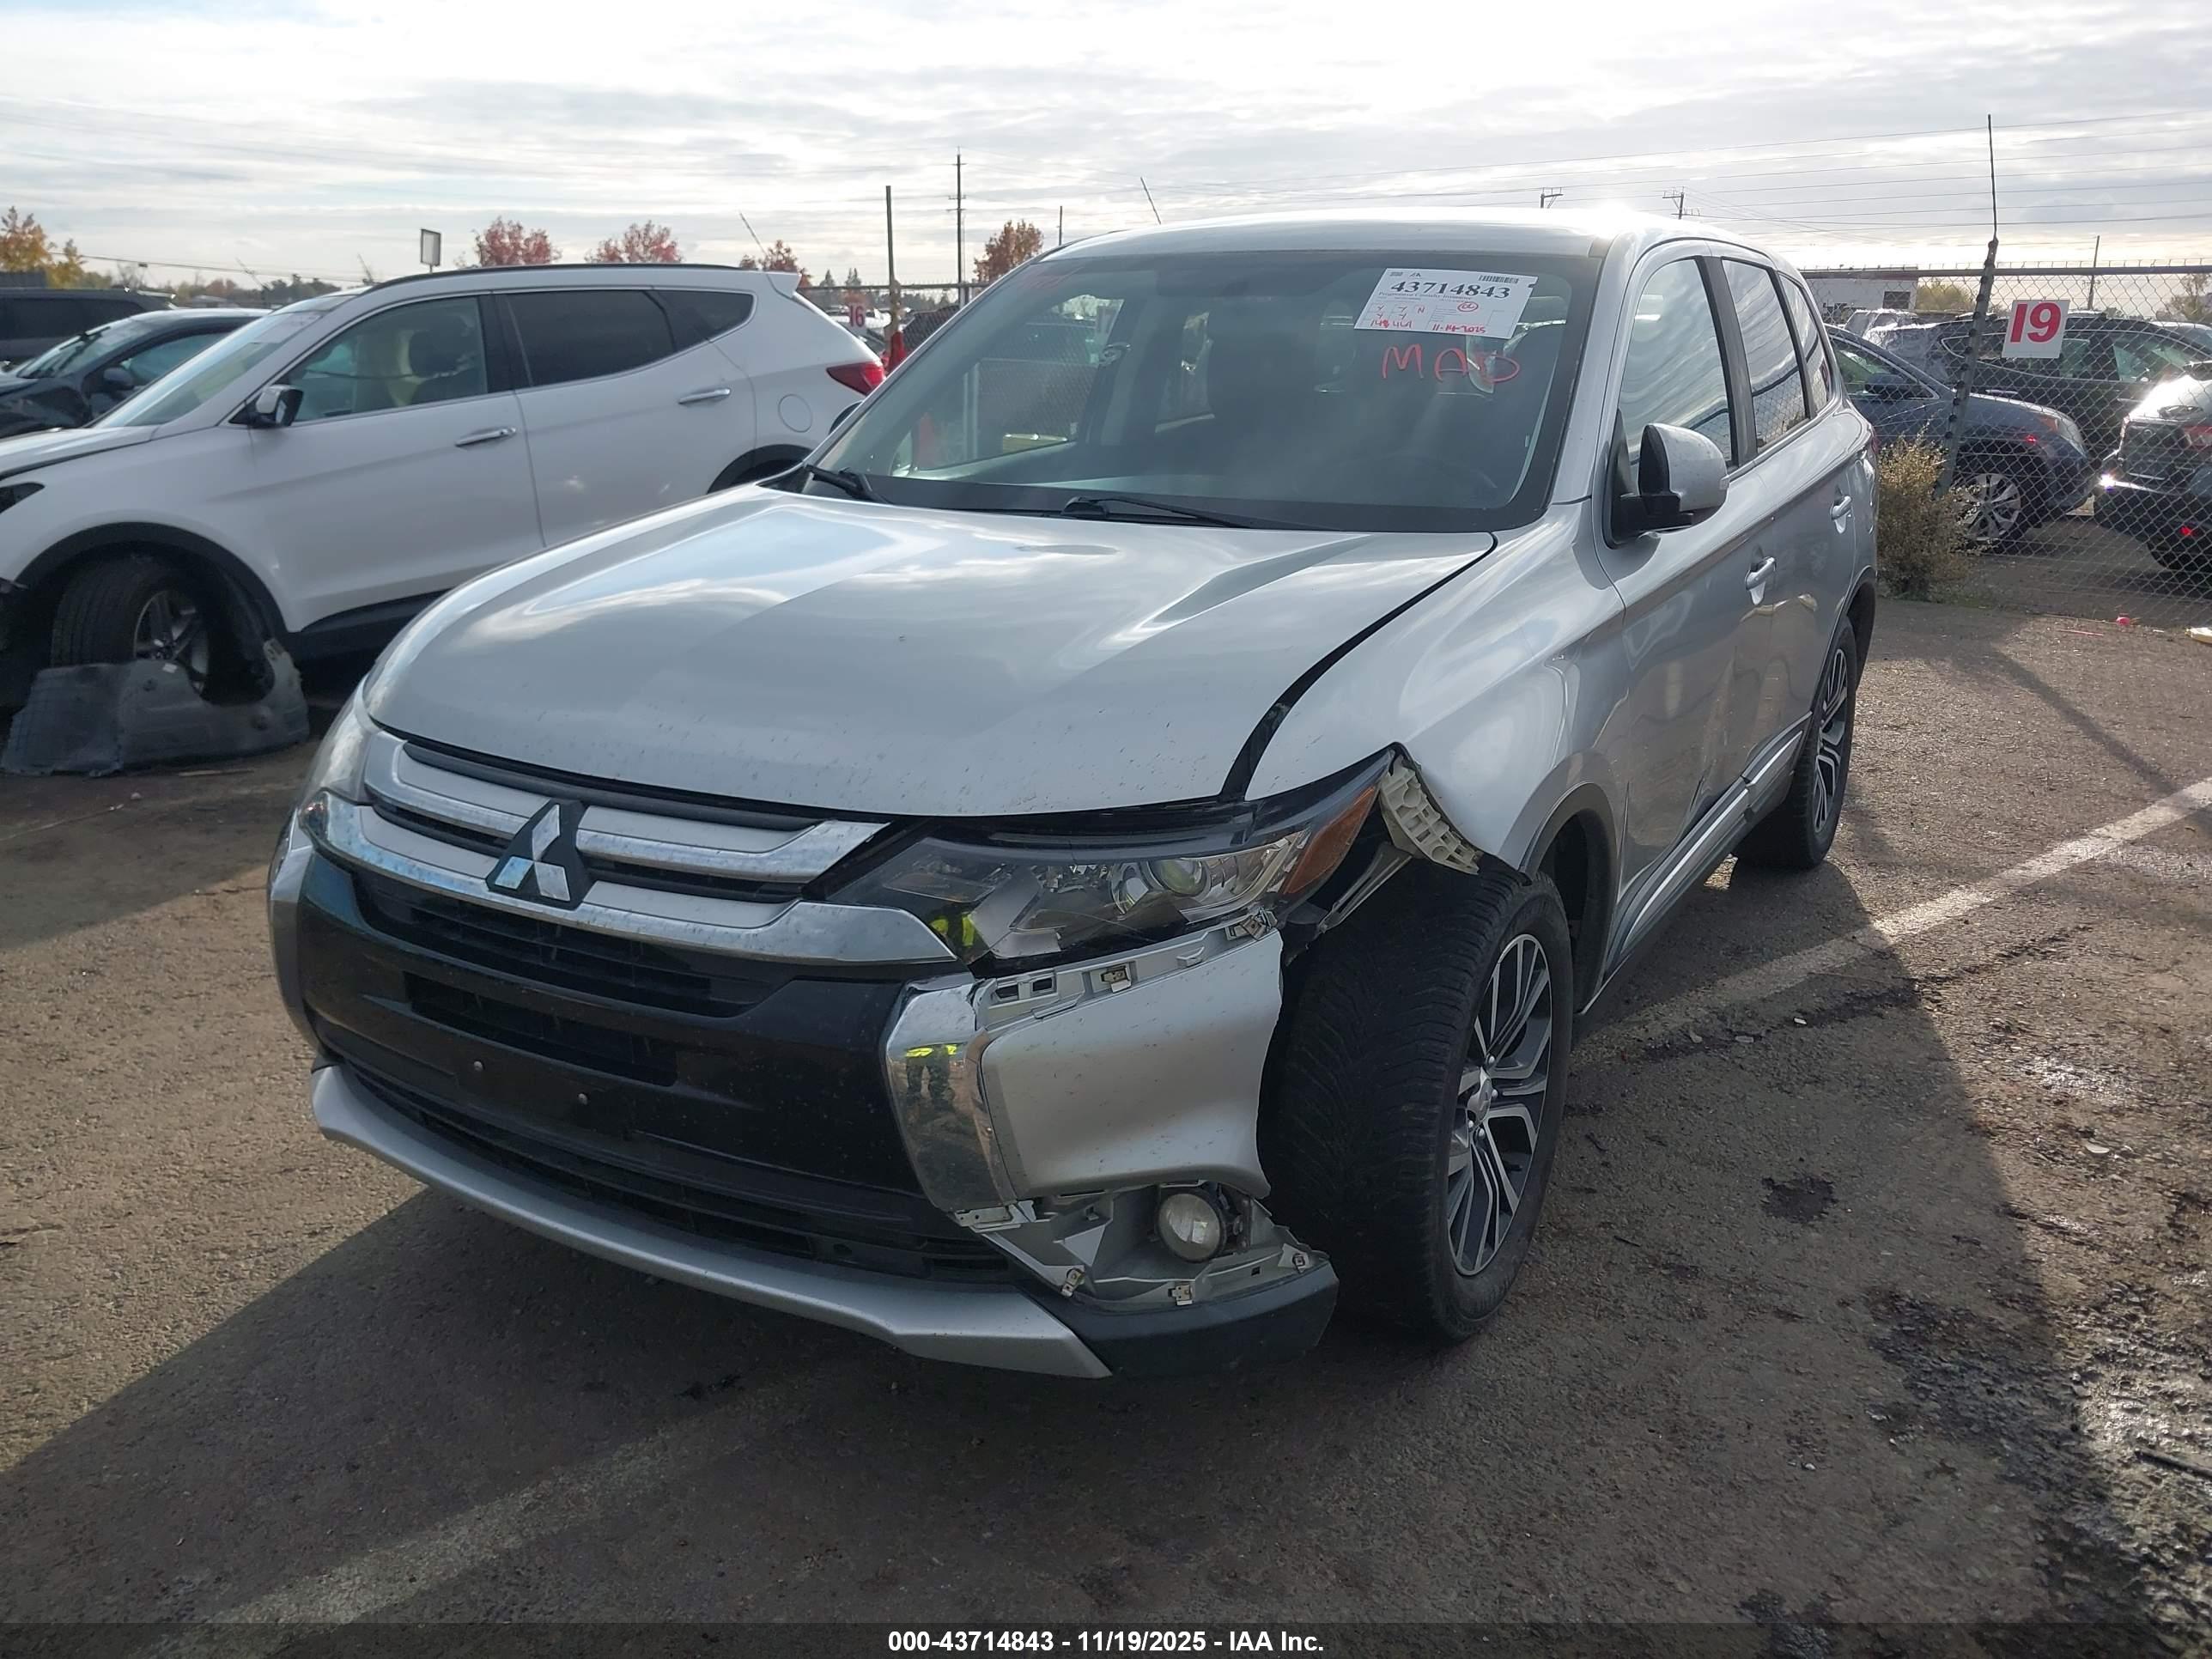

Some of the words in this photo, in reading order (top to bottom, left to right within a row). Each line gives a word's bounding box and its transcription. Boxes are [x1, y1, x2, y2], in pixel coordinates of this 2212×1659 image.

[1390, 281, 1510, 299] 43714843
[849, 306, 865, 327] 16
[2010, 302, 2061, 343] 19
